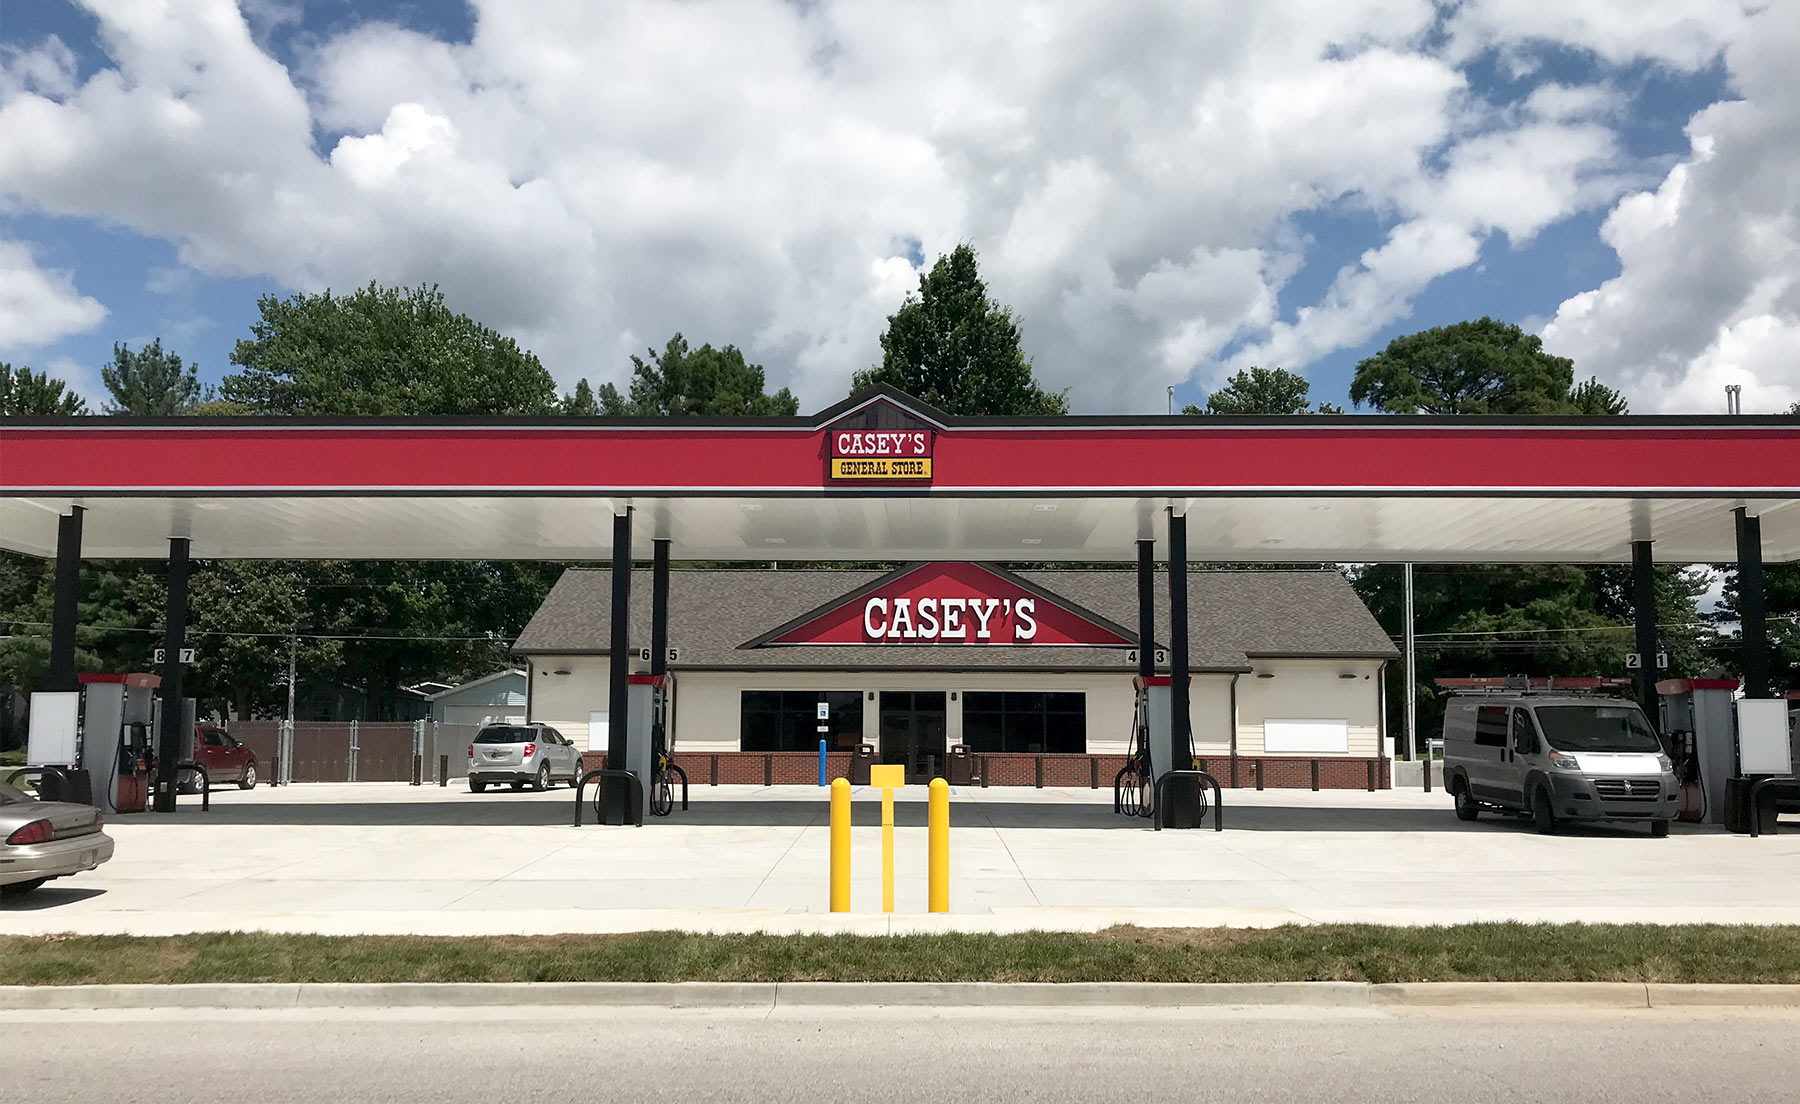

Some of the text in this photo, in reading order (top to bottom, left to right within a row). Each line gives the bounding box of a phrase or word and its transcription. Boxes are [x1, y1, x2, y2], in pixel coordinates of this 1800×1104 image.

[838, 433, 925, 454] CASEY'S
[841, 461, 923, 475] GENERAL STORE
[864, 597, 1037, 639] CASEY'S
[157, 650, 164, 662] 8
[184, 650, 192, 661] 7
[642, 649, 650, 660] 6
[669, 649, 677, 661] 5
[1128, 651, 1137, 662] 4
[1156, 651, 1164, 662] 3
[1628, 655, 1637, 666] 2
